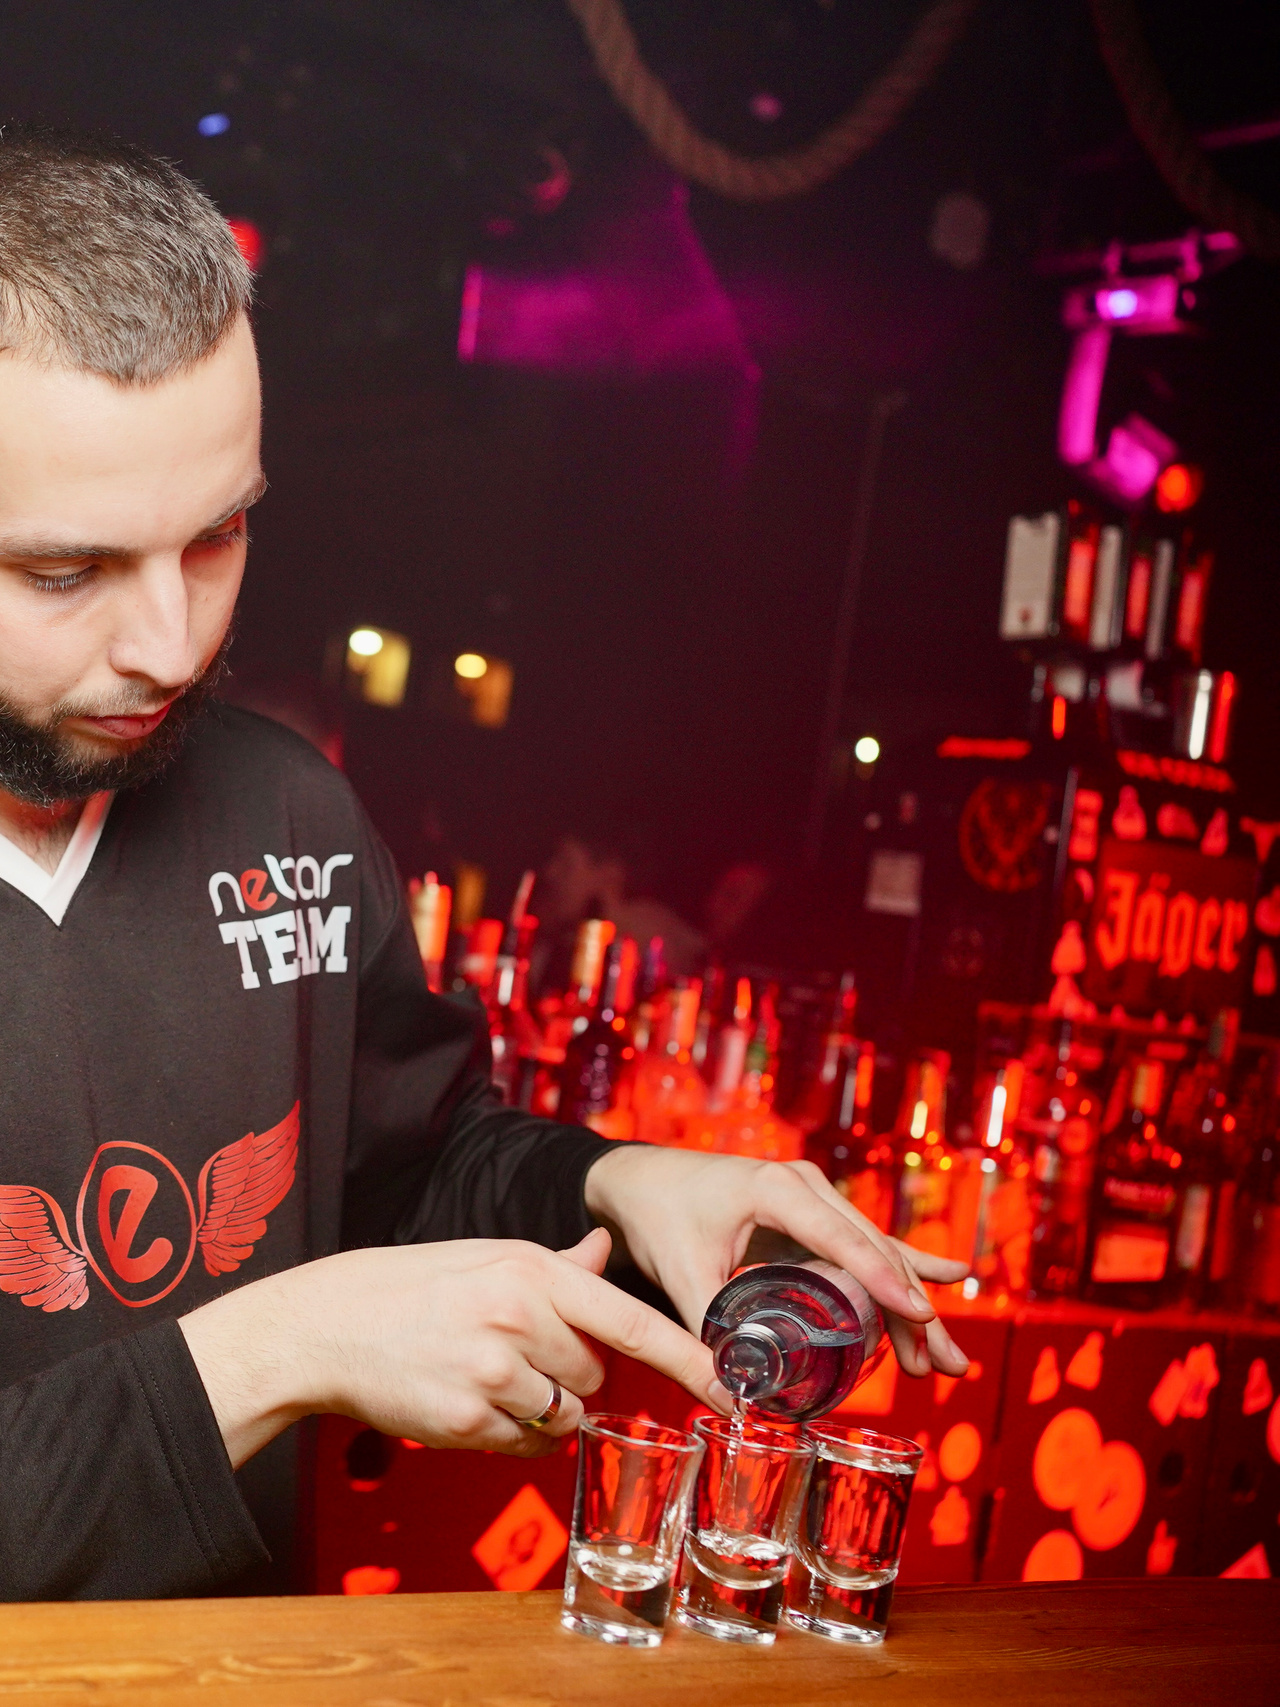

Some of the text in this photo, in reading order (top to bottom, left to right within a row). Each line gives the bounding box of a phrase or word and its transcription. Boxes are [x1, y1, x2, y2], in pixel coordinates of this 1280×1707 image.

[218, 906, 351, 990] TEAM
[1095, 868, 1248, 978] Jäger
[98, 1165, 173, 1283] e
